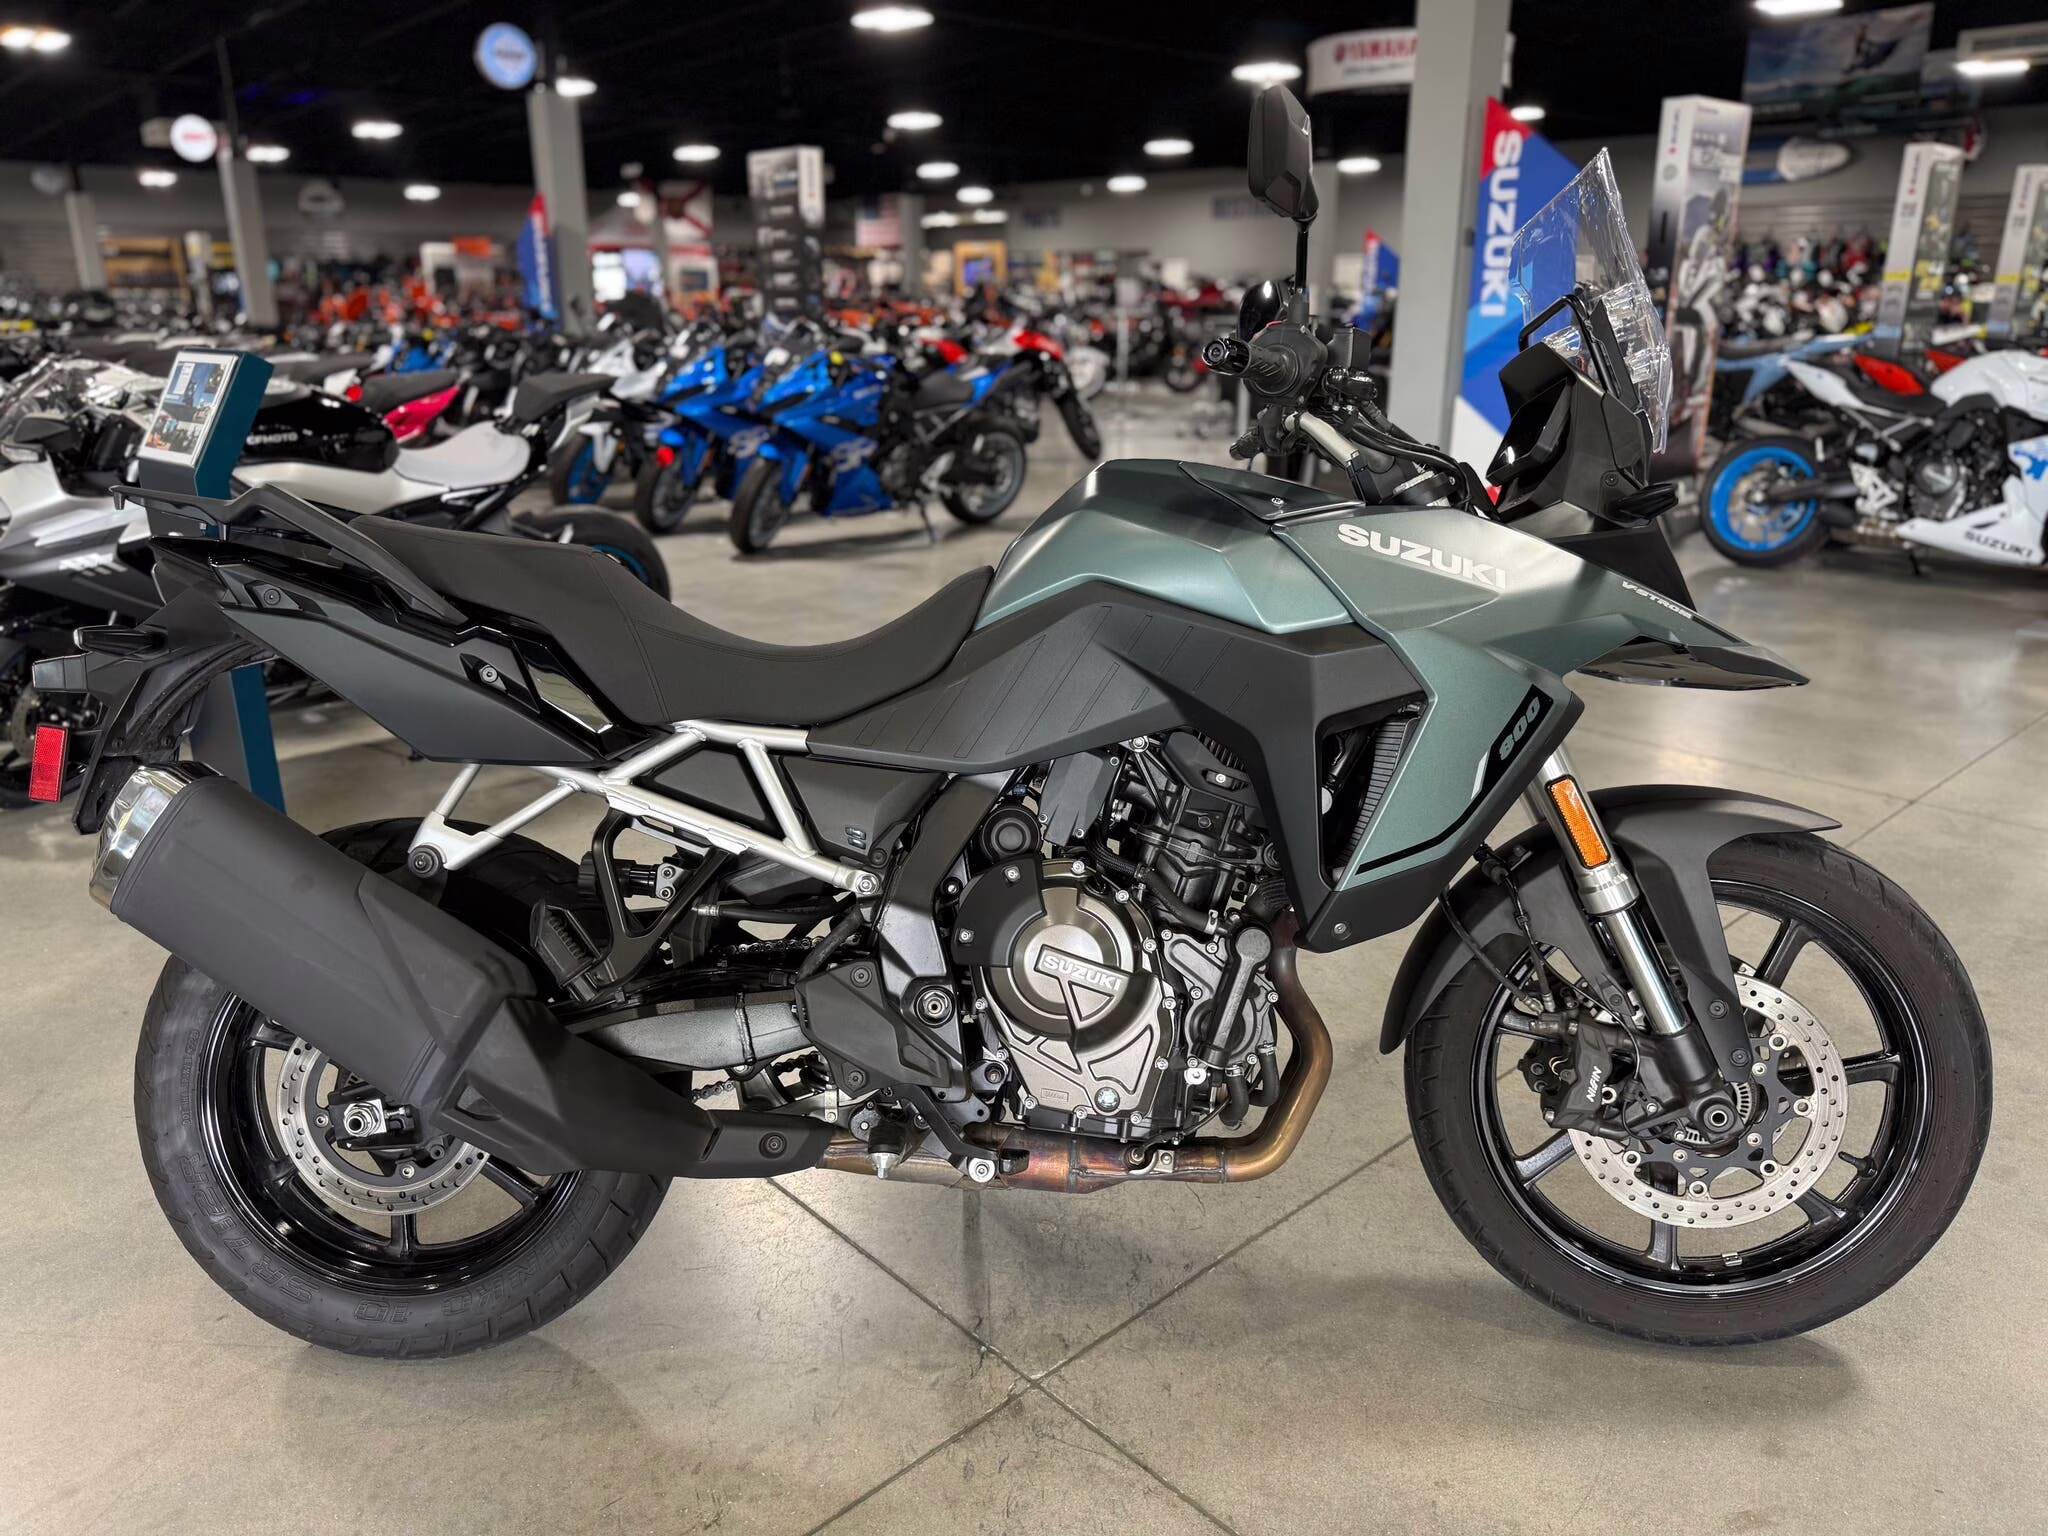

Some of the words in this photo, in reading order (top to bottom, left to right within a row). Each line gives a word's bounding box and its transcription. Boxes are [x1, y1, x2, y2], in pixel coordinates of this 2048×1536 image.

[1479, 129, 1524, 317] SUZUKI
[1337, 523, 1506, 590] SUZUKI
[1964, 530, 2034, 558] SUZUKI
[1622, 580, 1692, 619] V-STROM
[1499, 696, 1541, 761] 800
[1043, 955, 1122, 991] SUZUKI
